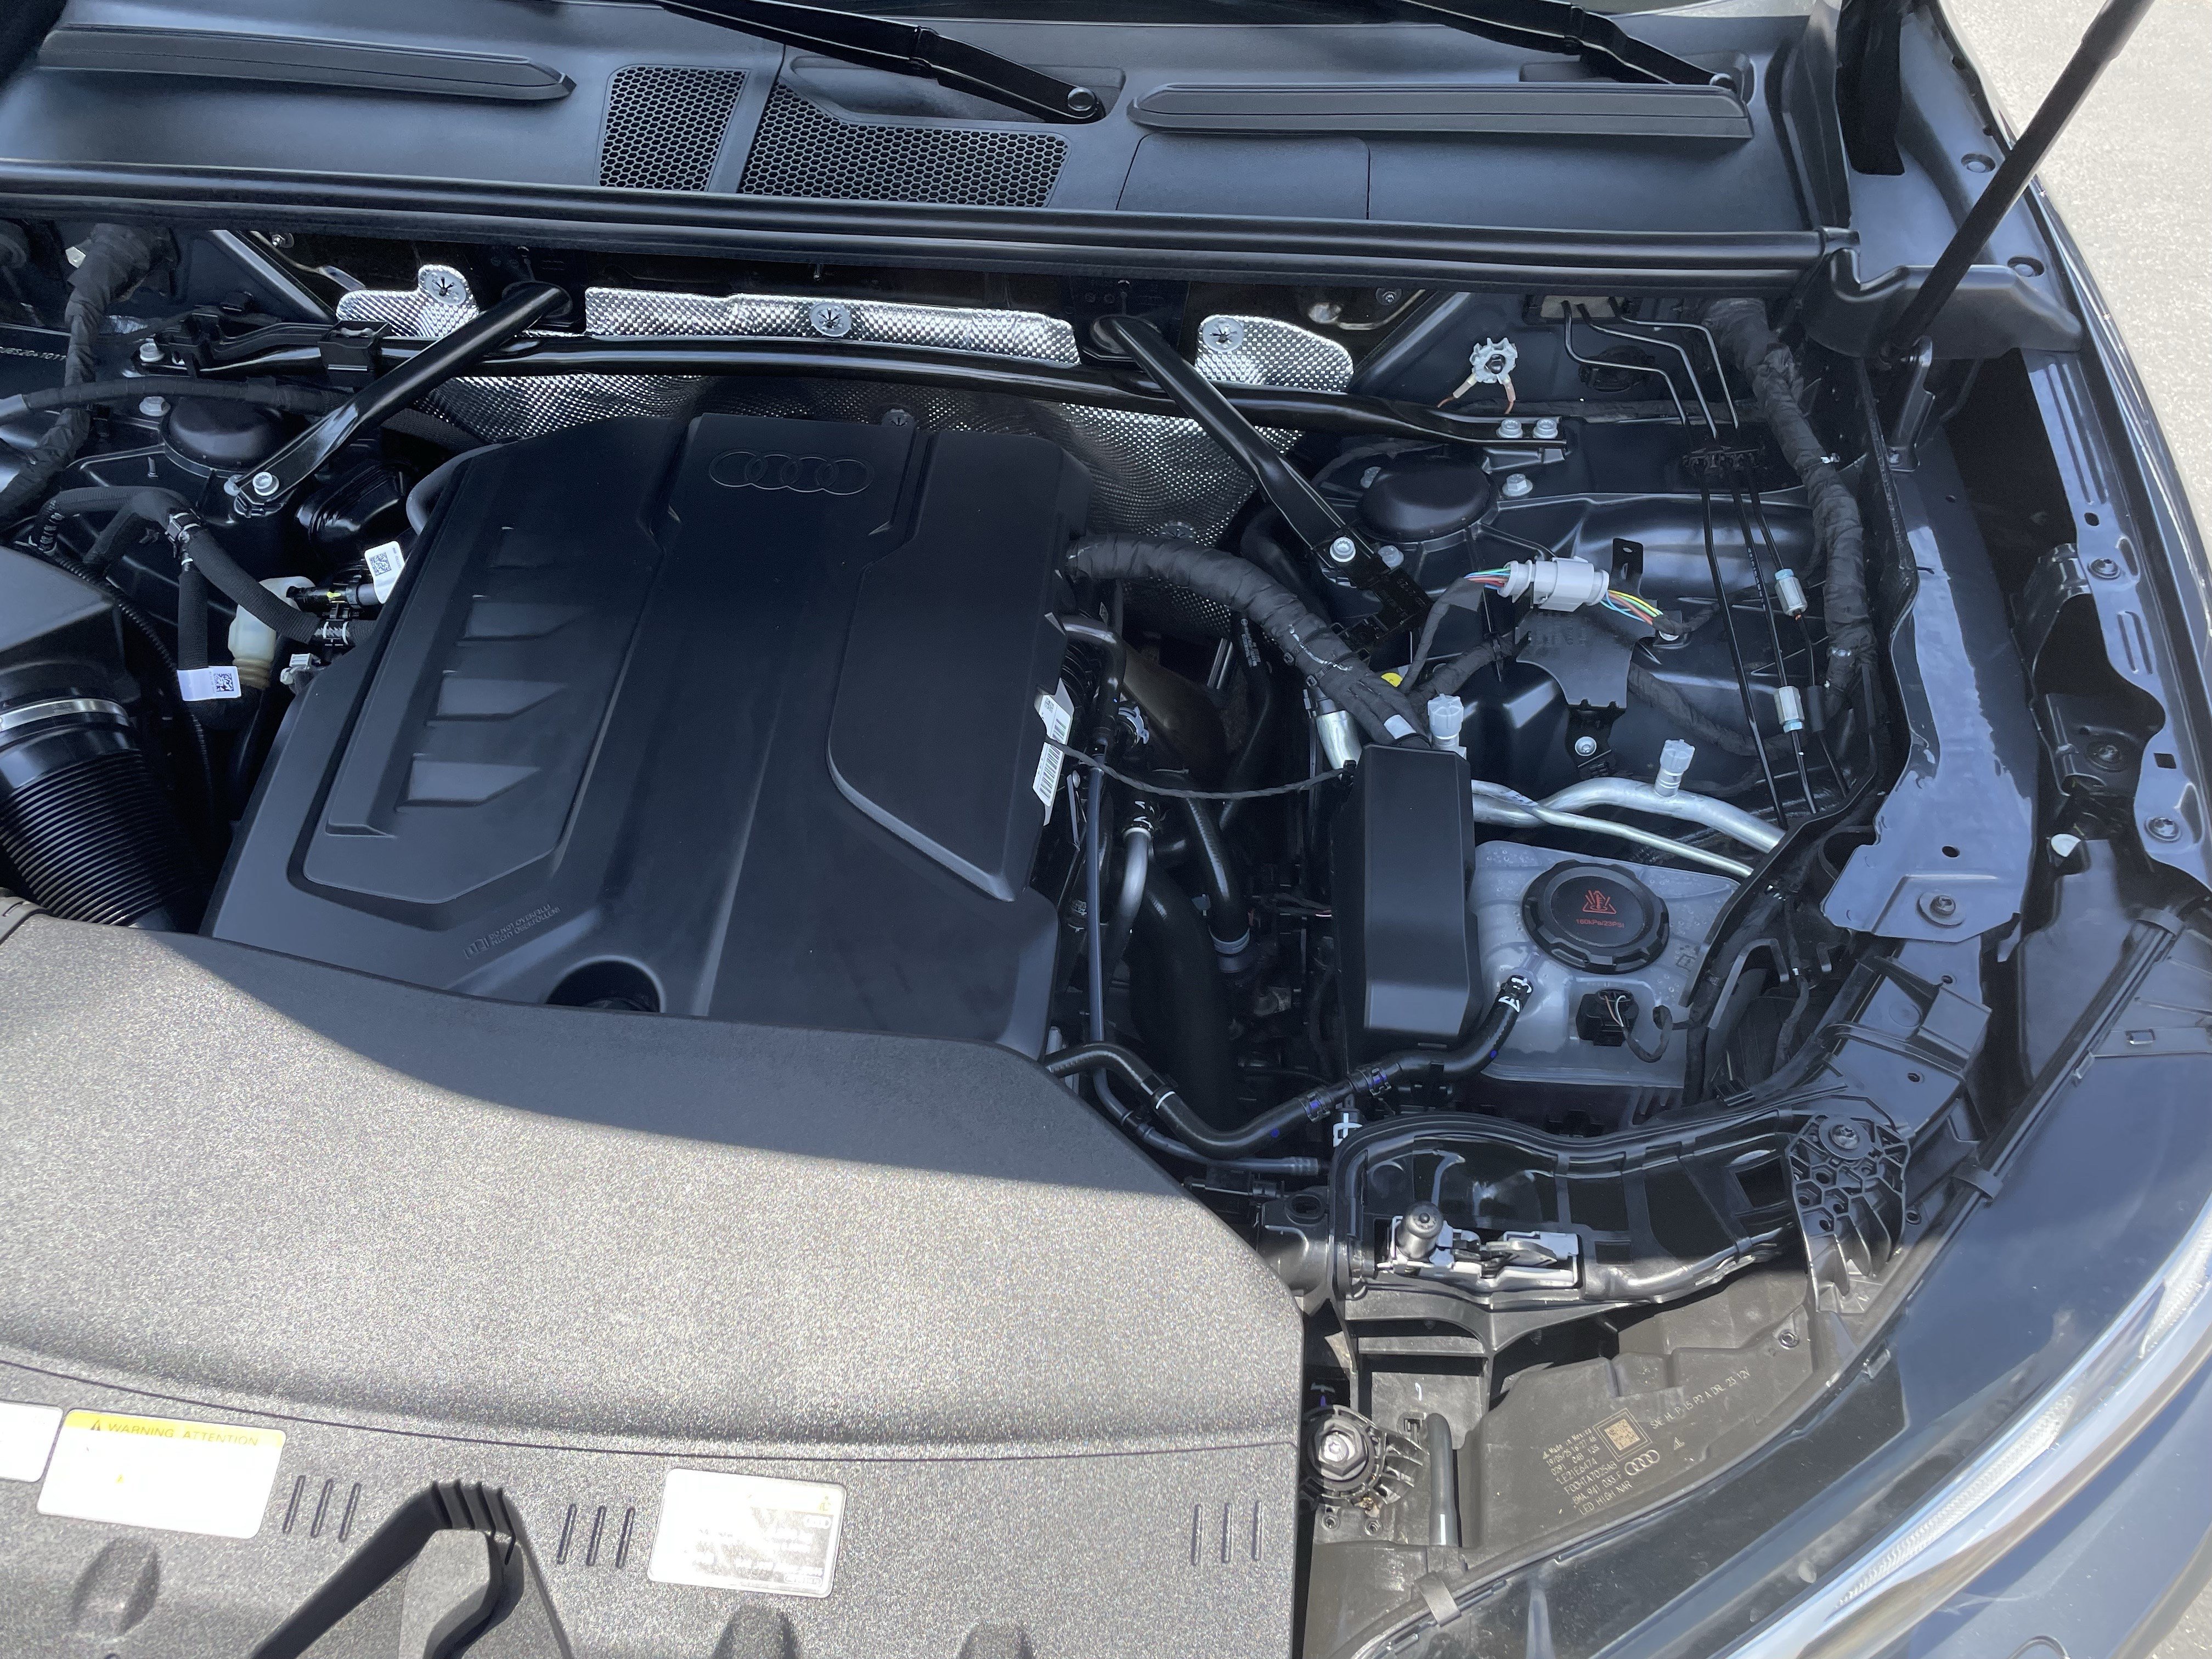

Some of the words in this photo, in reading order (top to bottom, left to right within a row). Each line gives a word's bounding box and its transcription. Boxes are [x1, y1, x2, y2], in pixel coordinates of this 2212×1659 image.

[1736, 1366, 1751, 1380] 12V
[109, 1423, 173, 1438] WARNING
[183, 1431, 259, 1446] ATTENTION
[1578, 1502, 1595, 1516] LED
[1595, 1489, 1617, 1506] HIGH
[1615, 1480, 1633, 1494] NAR
